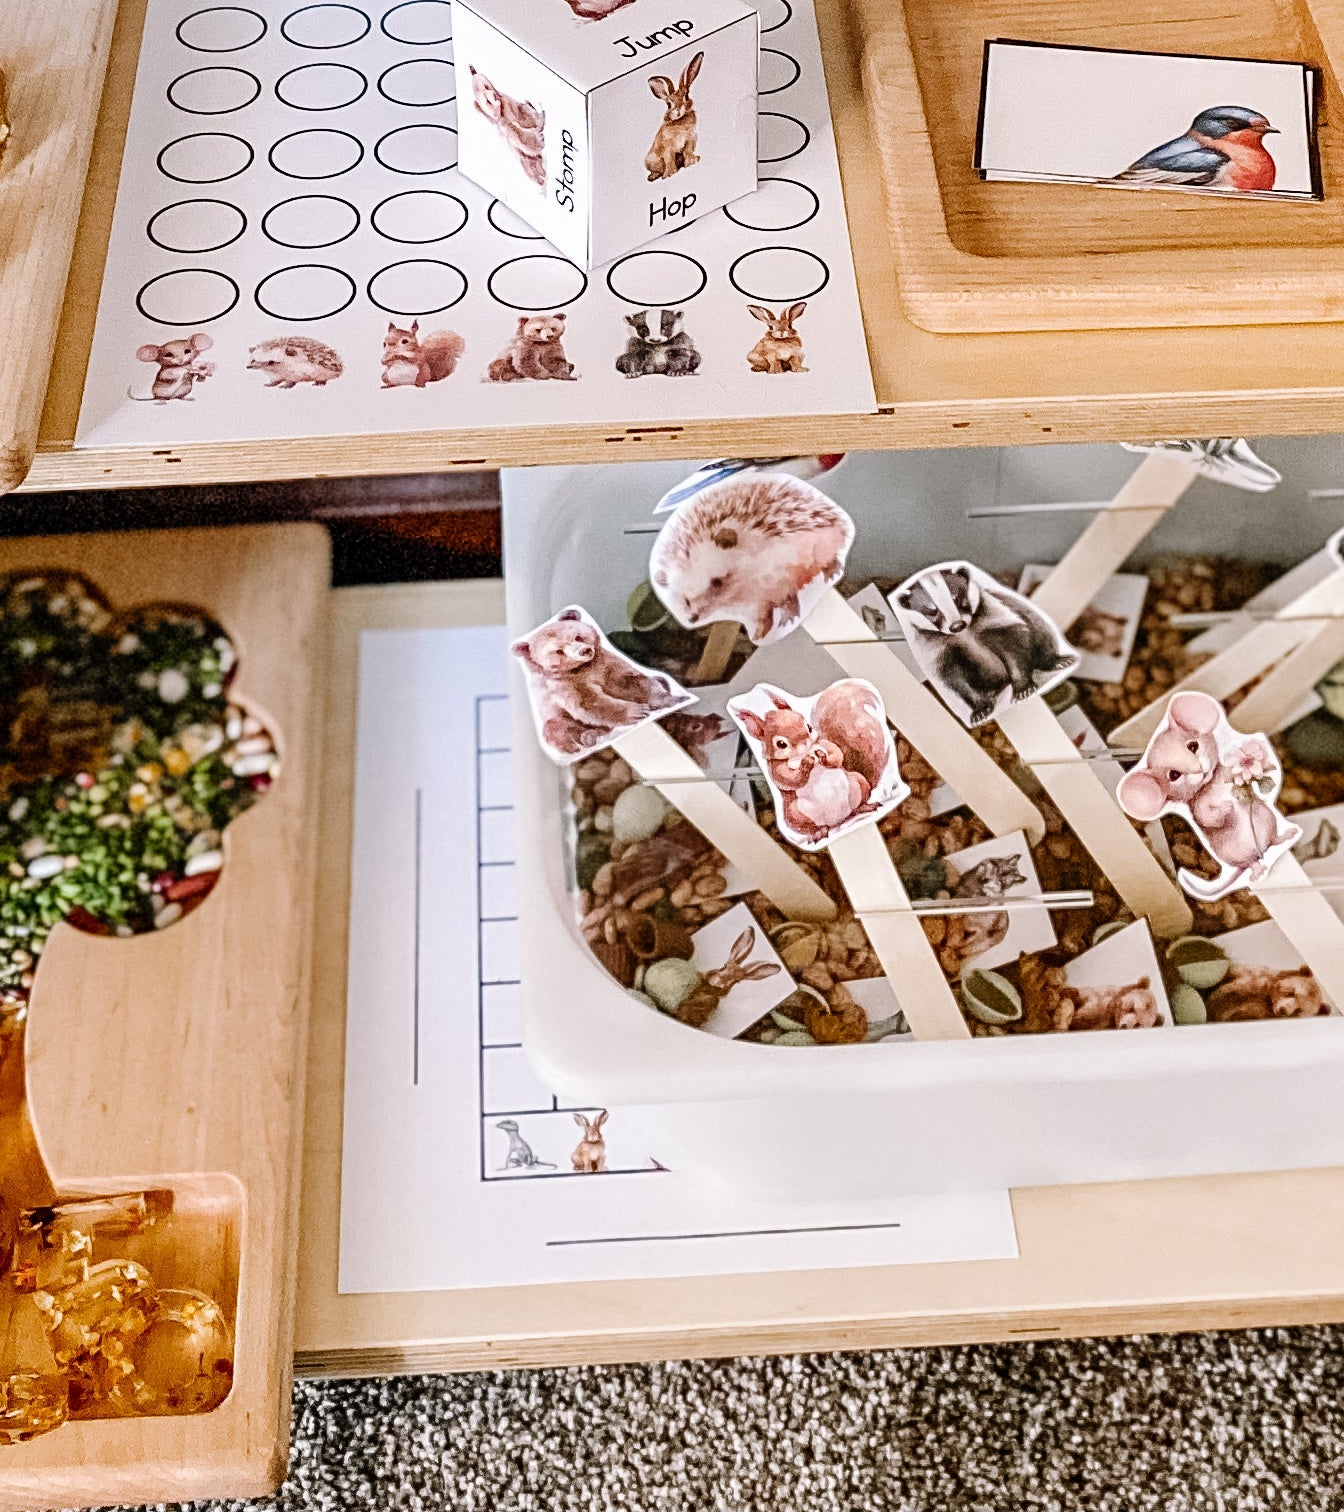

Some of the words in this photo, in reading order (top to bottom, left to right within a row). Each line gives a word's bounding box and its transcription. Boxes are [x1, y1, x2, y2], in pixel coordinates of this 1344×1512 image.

[613, 20, 694, 57] Jump
[556, 129, 578, 212] Stomp
[649, 193, 697, 227] Hop
